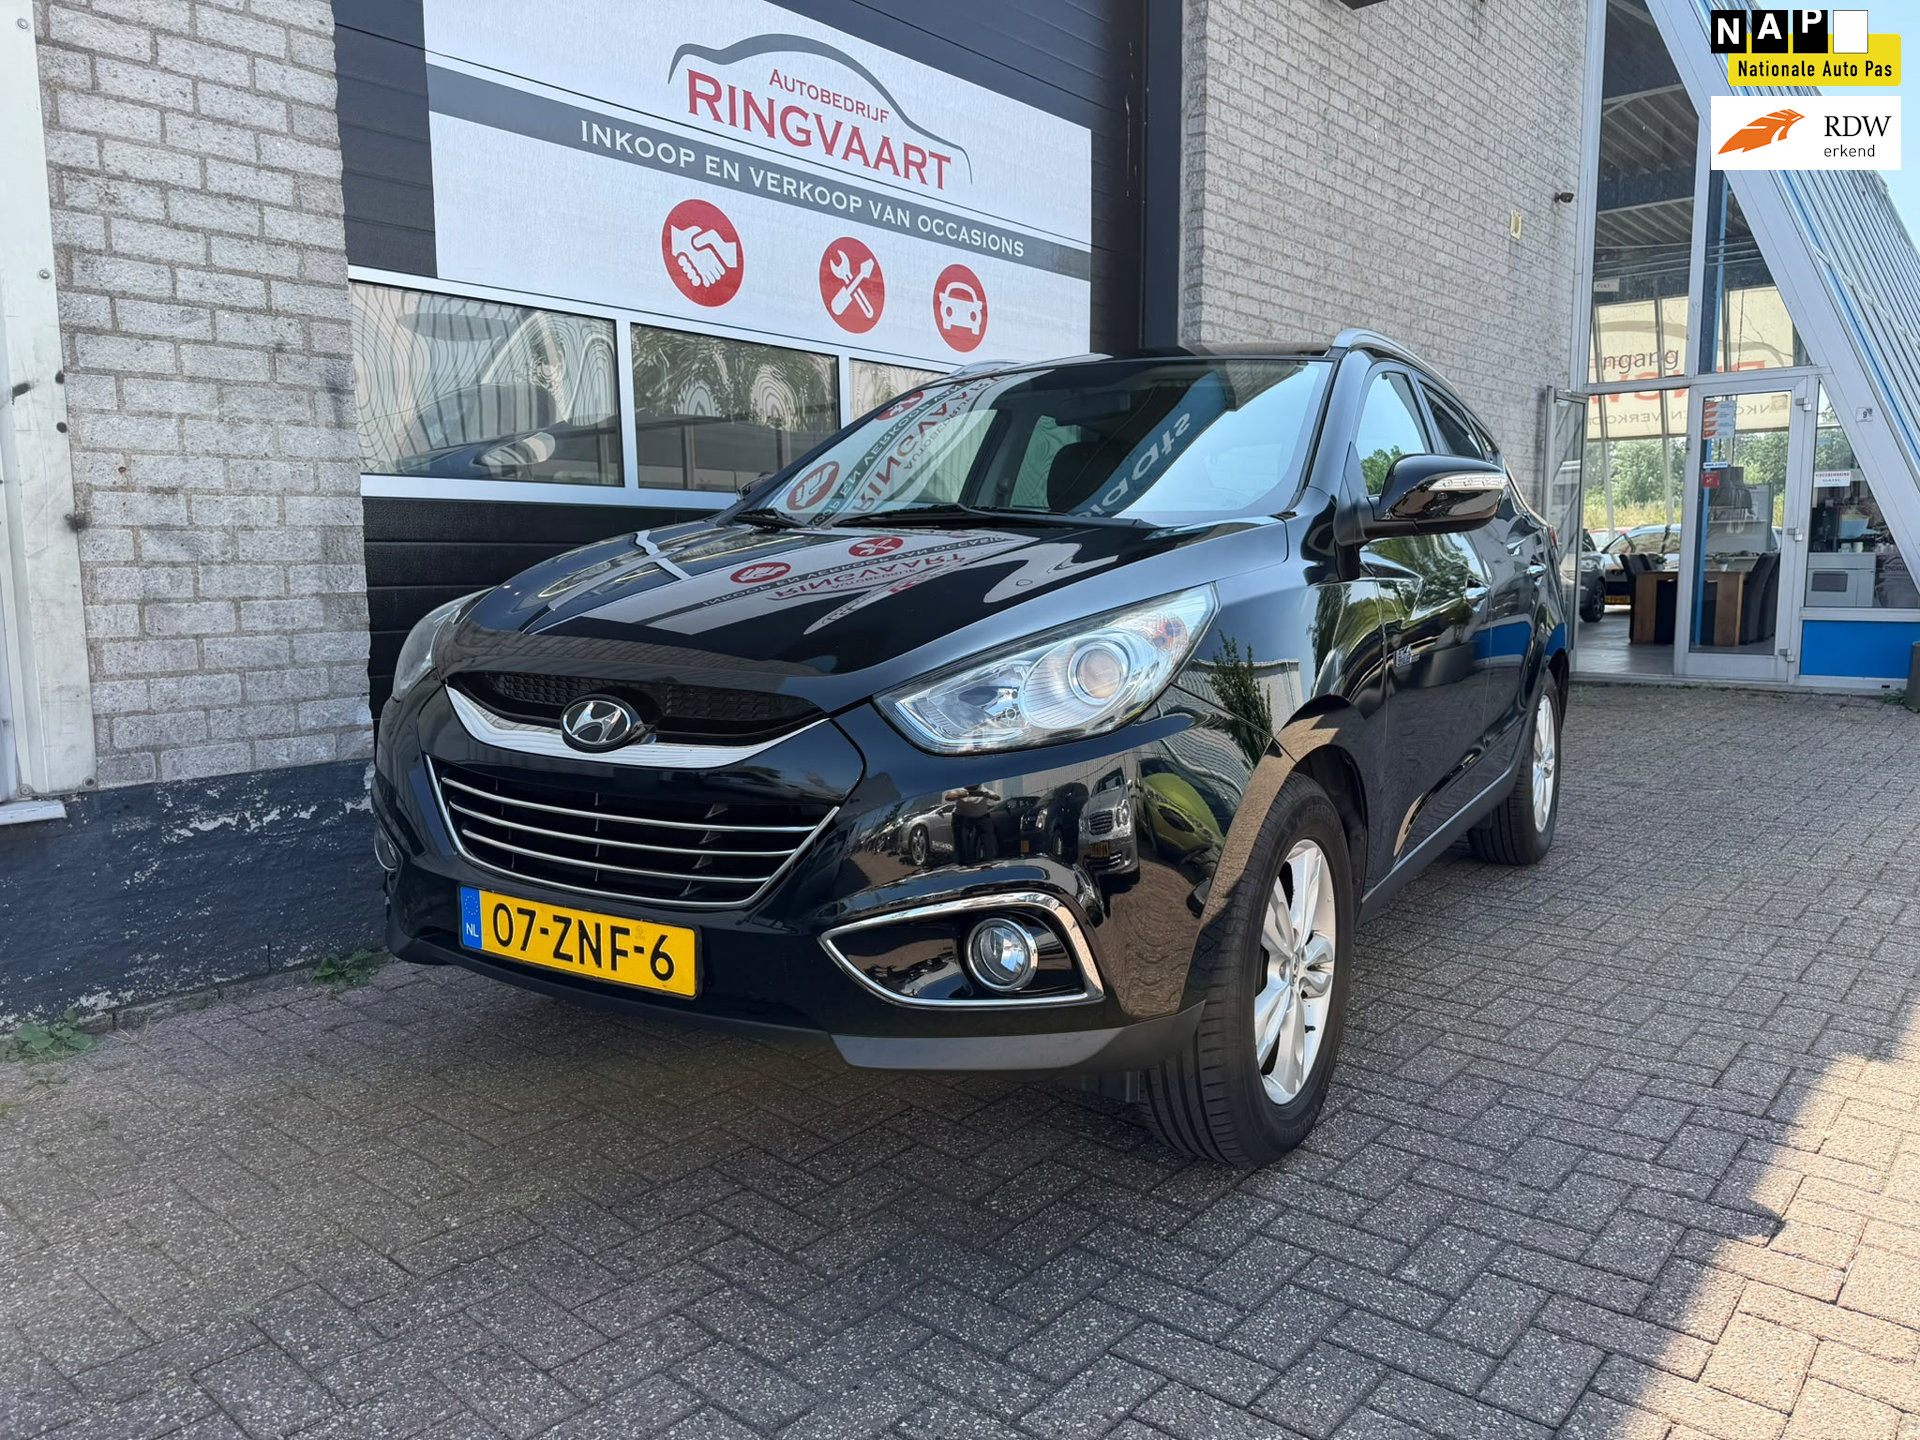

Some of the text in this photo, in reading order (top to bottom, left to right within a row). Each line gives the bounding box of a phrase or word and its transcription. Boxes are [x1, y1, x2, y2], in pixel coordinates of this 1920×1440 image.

[687, 68, 952, 190] RINGVAART
[769, 69, 890, 124] AUTOBEDRIJF
[581, 120, 1024, 259] INKOOP EN VERKOOP VAN OCCASIONS
[465, 922, 479, 938] NL
[492, 902, 675, 982] 07-ZNF-6
